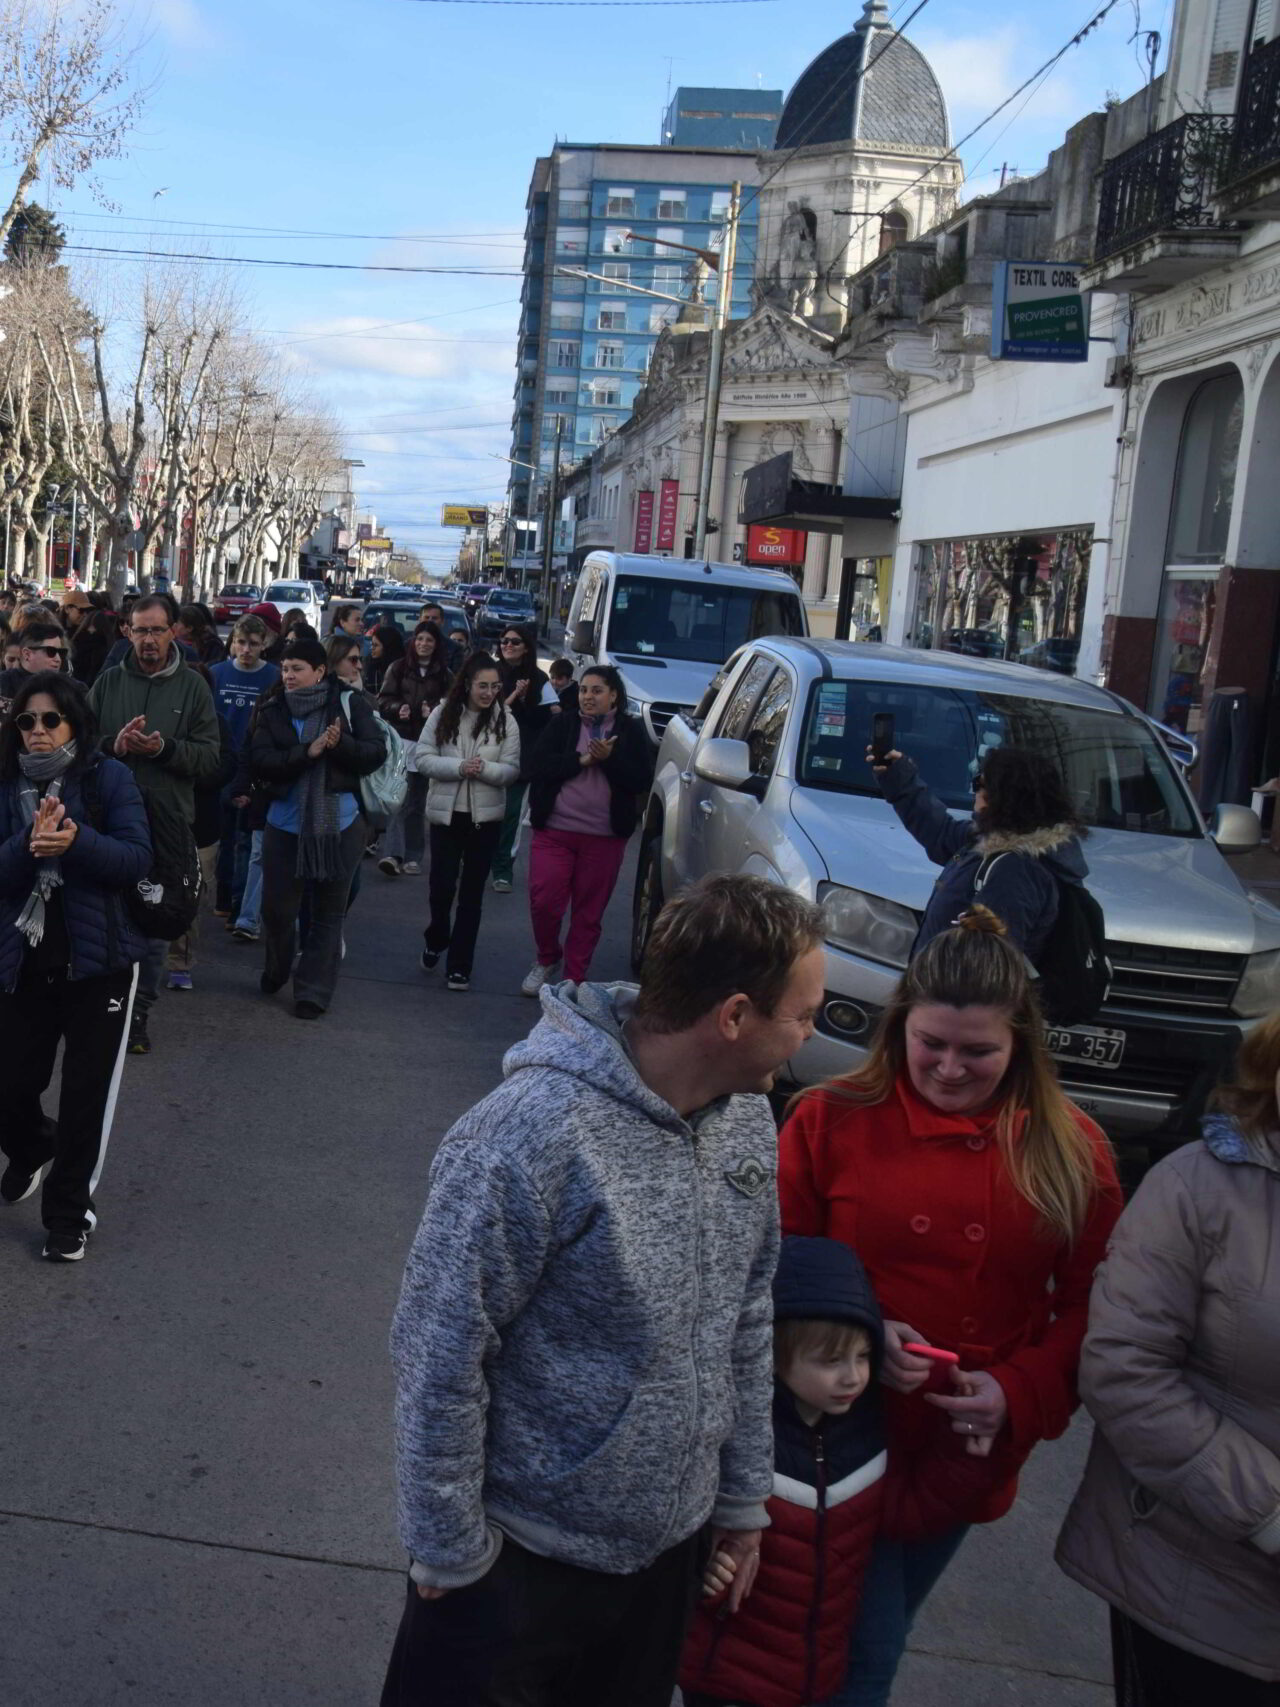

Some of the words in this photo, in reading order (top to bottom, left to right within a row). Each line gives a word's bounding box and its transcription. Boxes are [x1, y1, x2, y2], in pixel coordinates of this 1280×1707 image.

[1013, 269, 1047, 287] TEXTIL
[1014, 305, 1078, 322] PROVENCRED
[758, 545, 785, 556] open
[1080, 1036, 1121, 1061] 357
